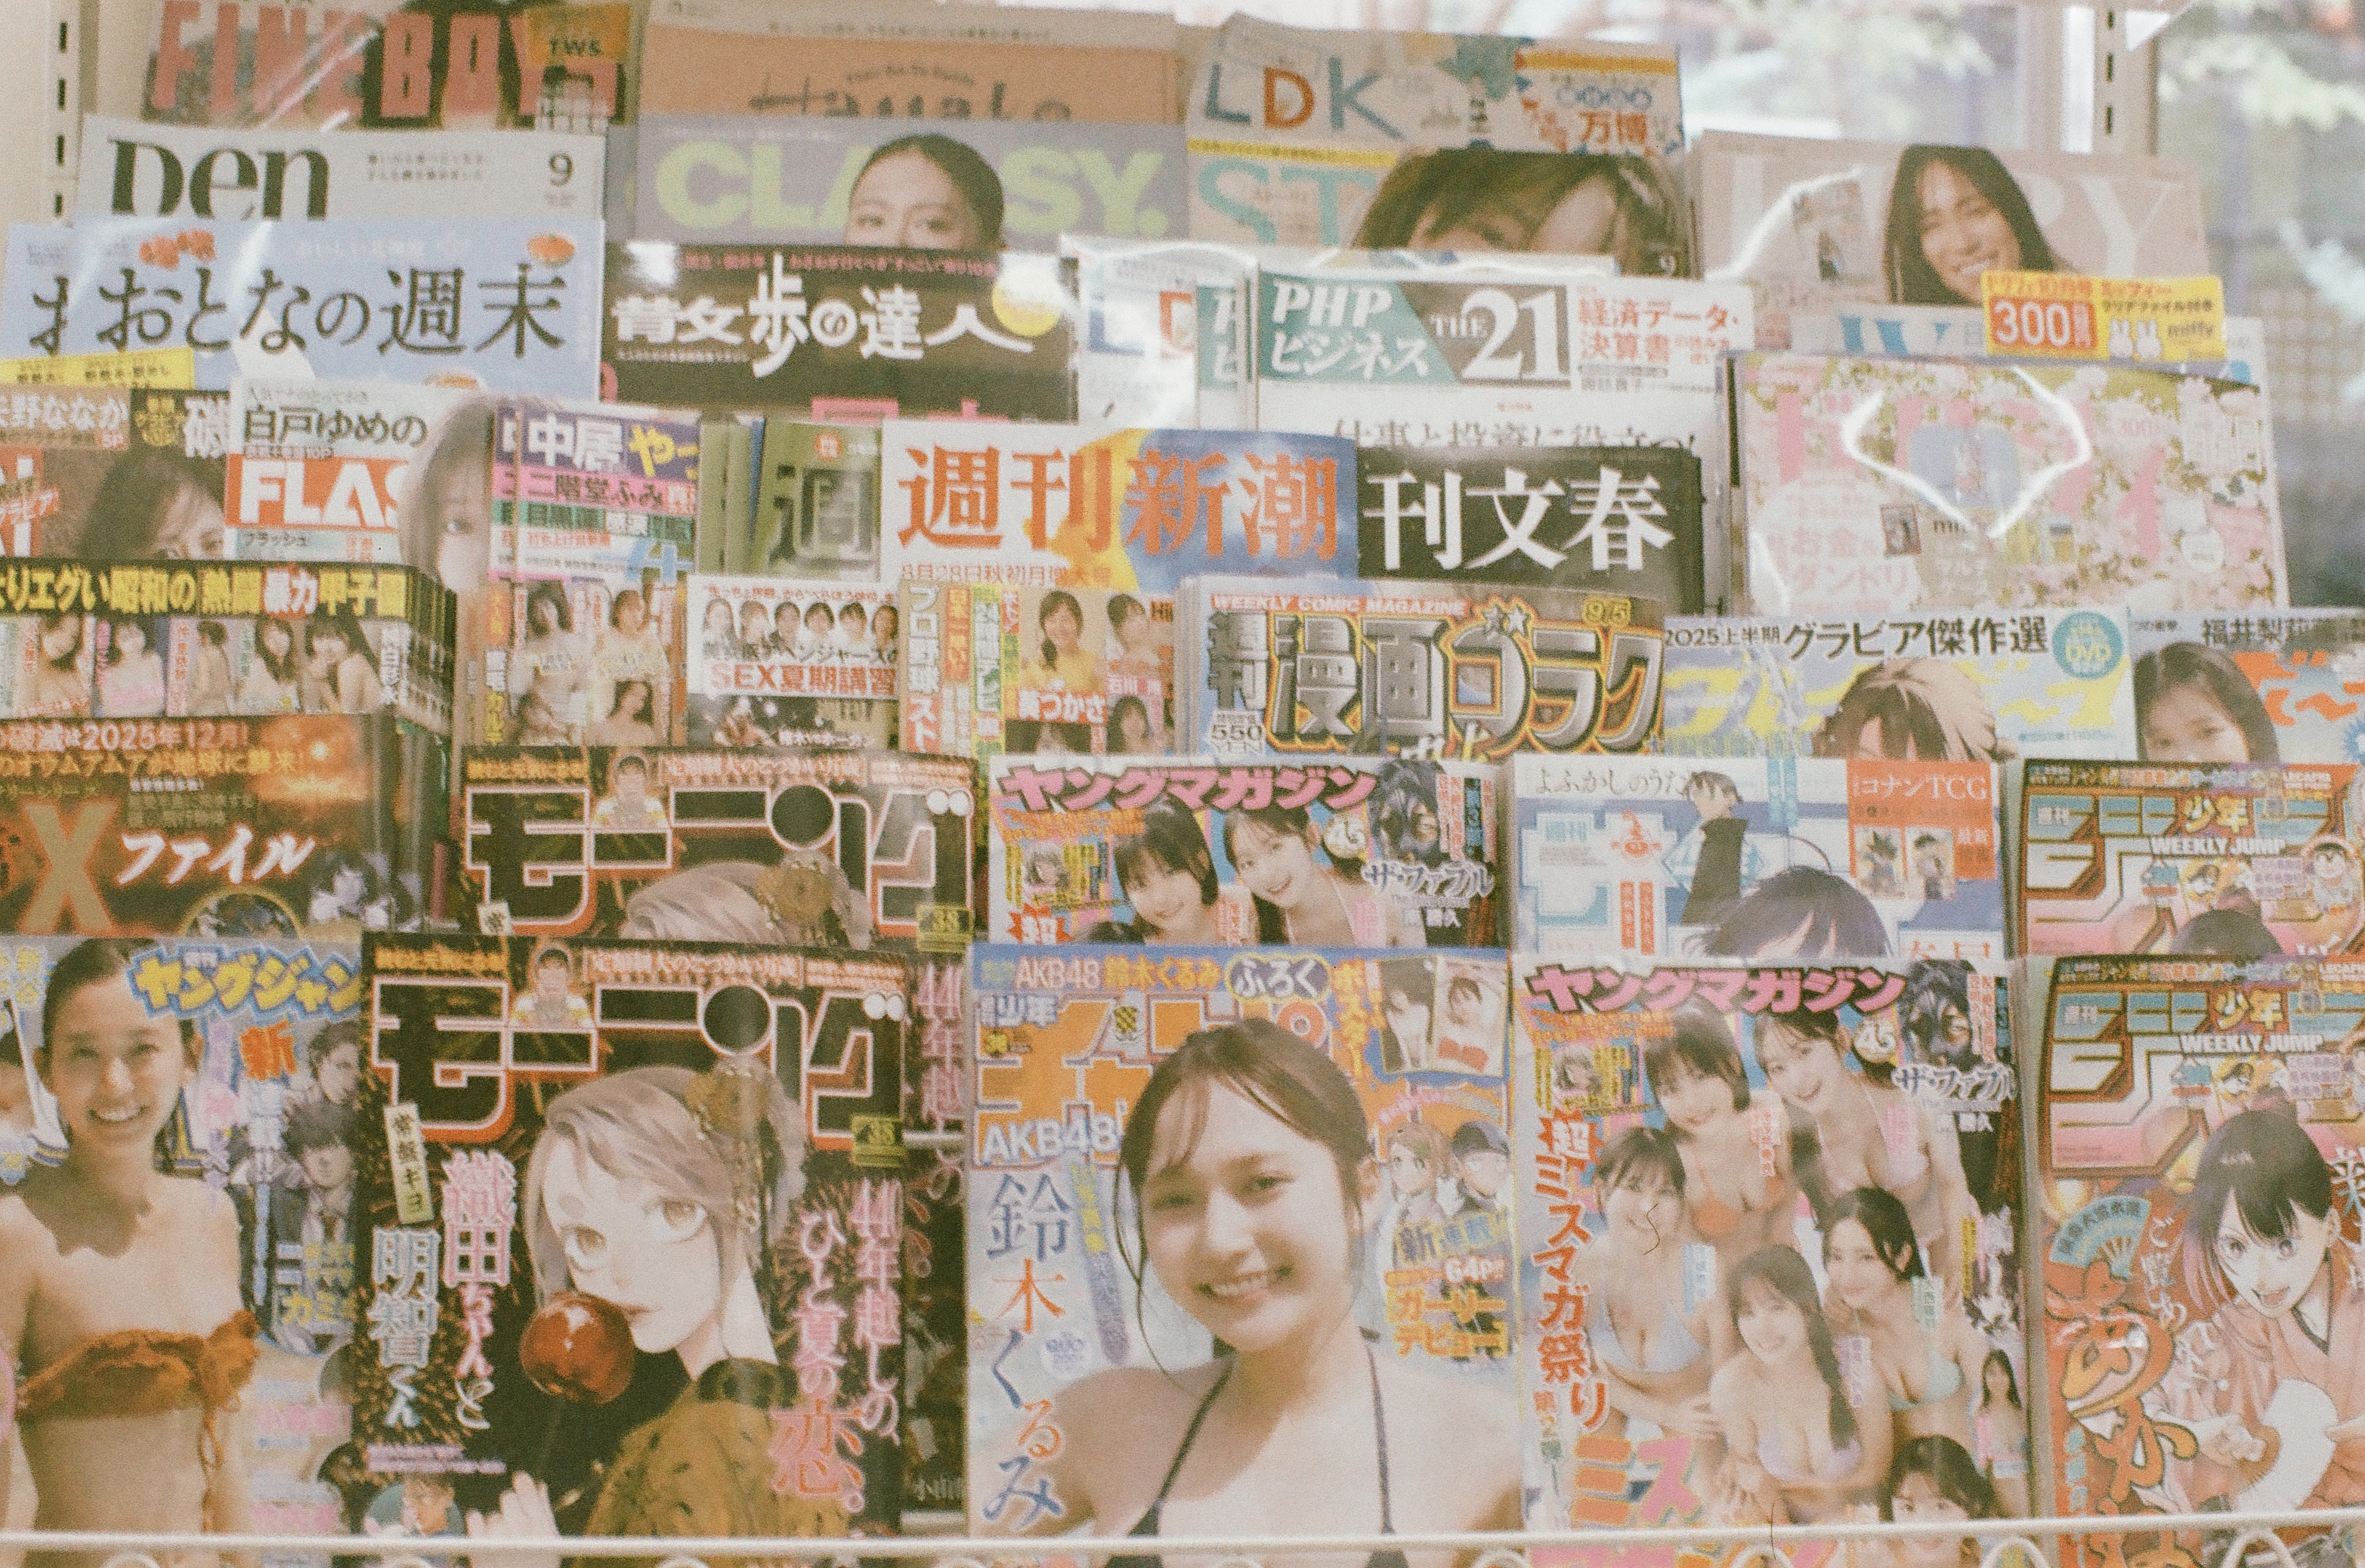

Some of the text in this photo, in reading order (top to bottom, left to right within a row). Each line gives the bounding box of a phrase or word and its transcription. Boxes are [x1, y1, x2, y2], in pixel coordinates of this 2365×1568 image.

[1203, 57, 1407, 142] LDK
[549, 153, 574, 187] 9
[655, 141, 1168, 239] CLSY.
[97, 264, 568, 359] おとなの週末
[1271, 280, 1394, 328] PHP
[1271, 332, 1430, 380] ビジネス
[1431, 313, 1485, 340] THE
[1464, 289, 1566, 380] 21
[243, 404, 429, 447] 白戸ゆめの
[898, 444, 1341, 561] 週刊新潮
[1212, 594, 1467, 616] WEEKLY COMIC MAGAZINE
[1784, 615, 2048, 660] グラビア傑作選
[1212, 722, 1263, 741] 550
[999, 765, 1377, 811] ヤングマガジン
[1860, 773, 1989, 801] コナンTCG
[2182, 793, 2249, 833] 少年
[2152, 837, 2286, 855] WEEKLY JUMP
[1016, 957, 1100, 990] AKB48
[1233, 957, 1325, 996] ふろく
[1529, 966, 1906, 1013] ヤングマガジン
[2214, 988, 2282, 1030] 少年
[2181, 1033, 2324, 1053] WEEKLY JUMP
[982, 1113, 1120, 1166] AKB48
